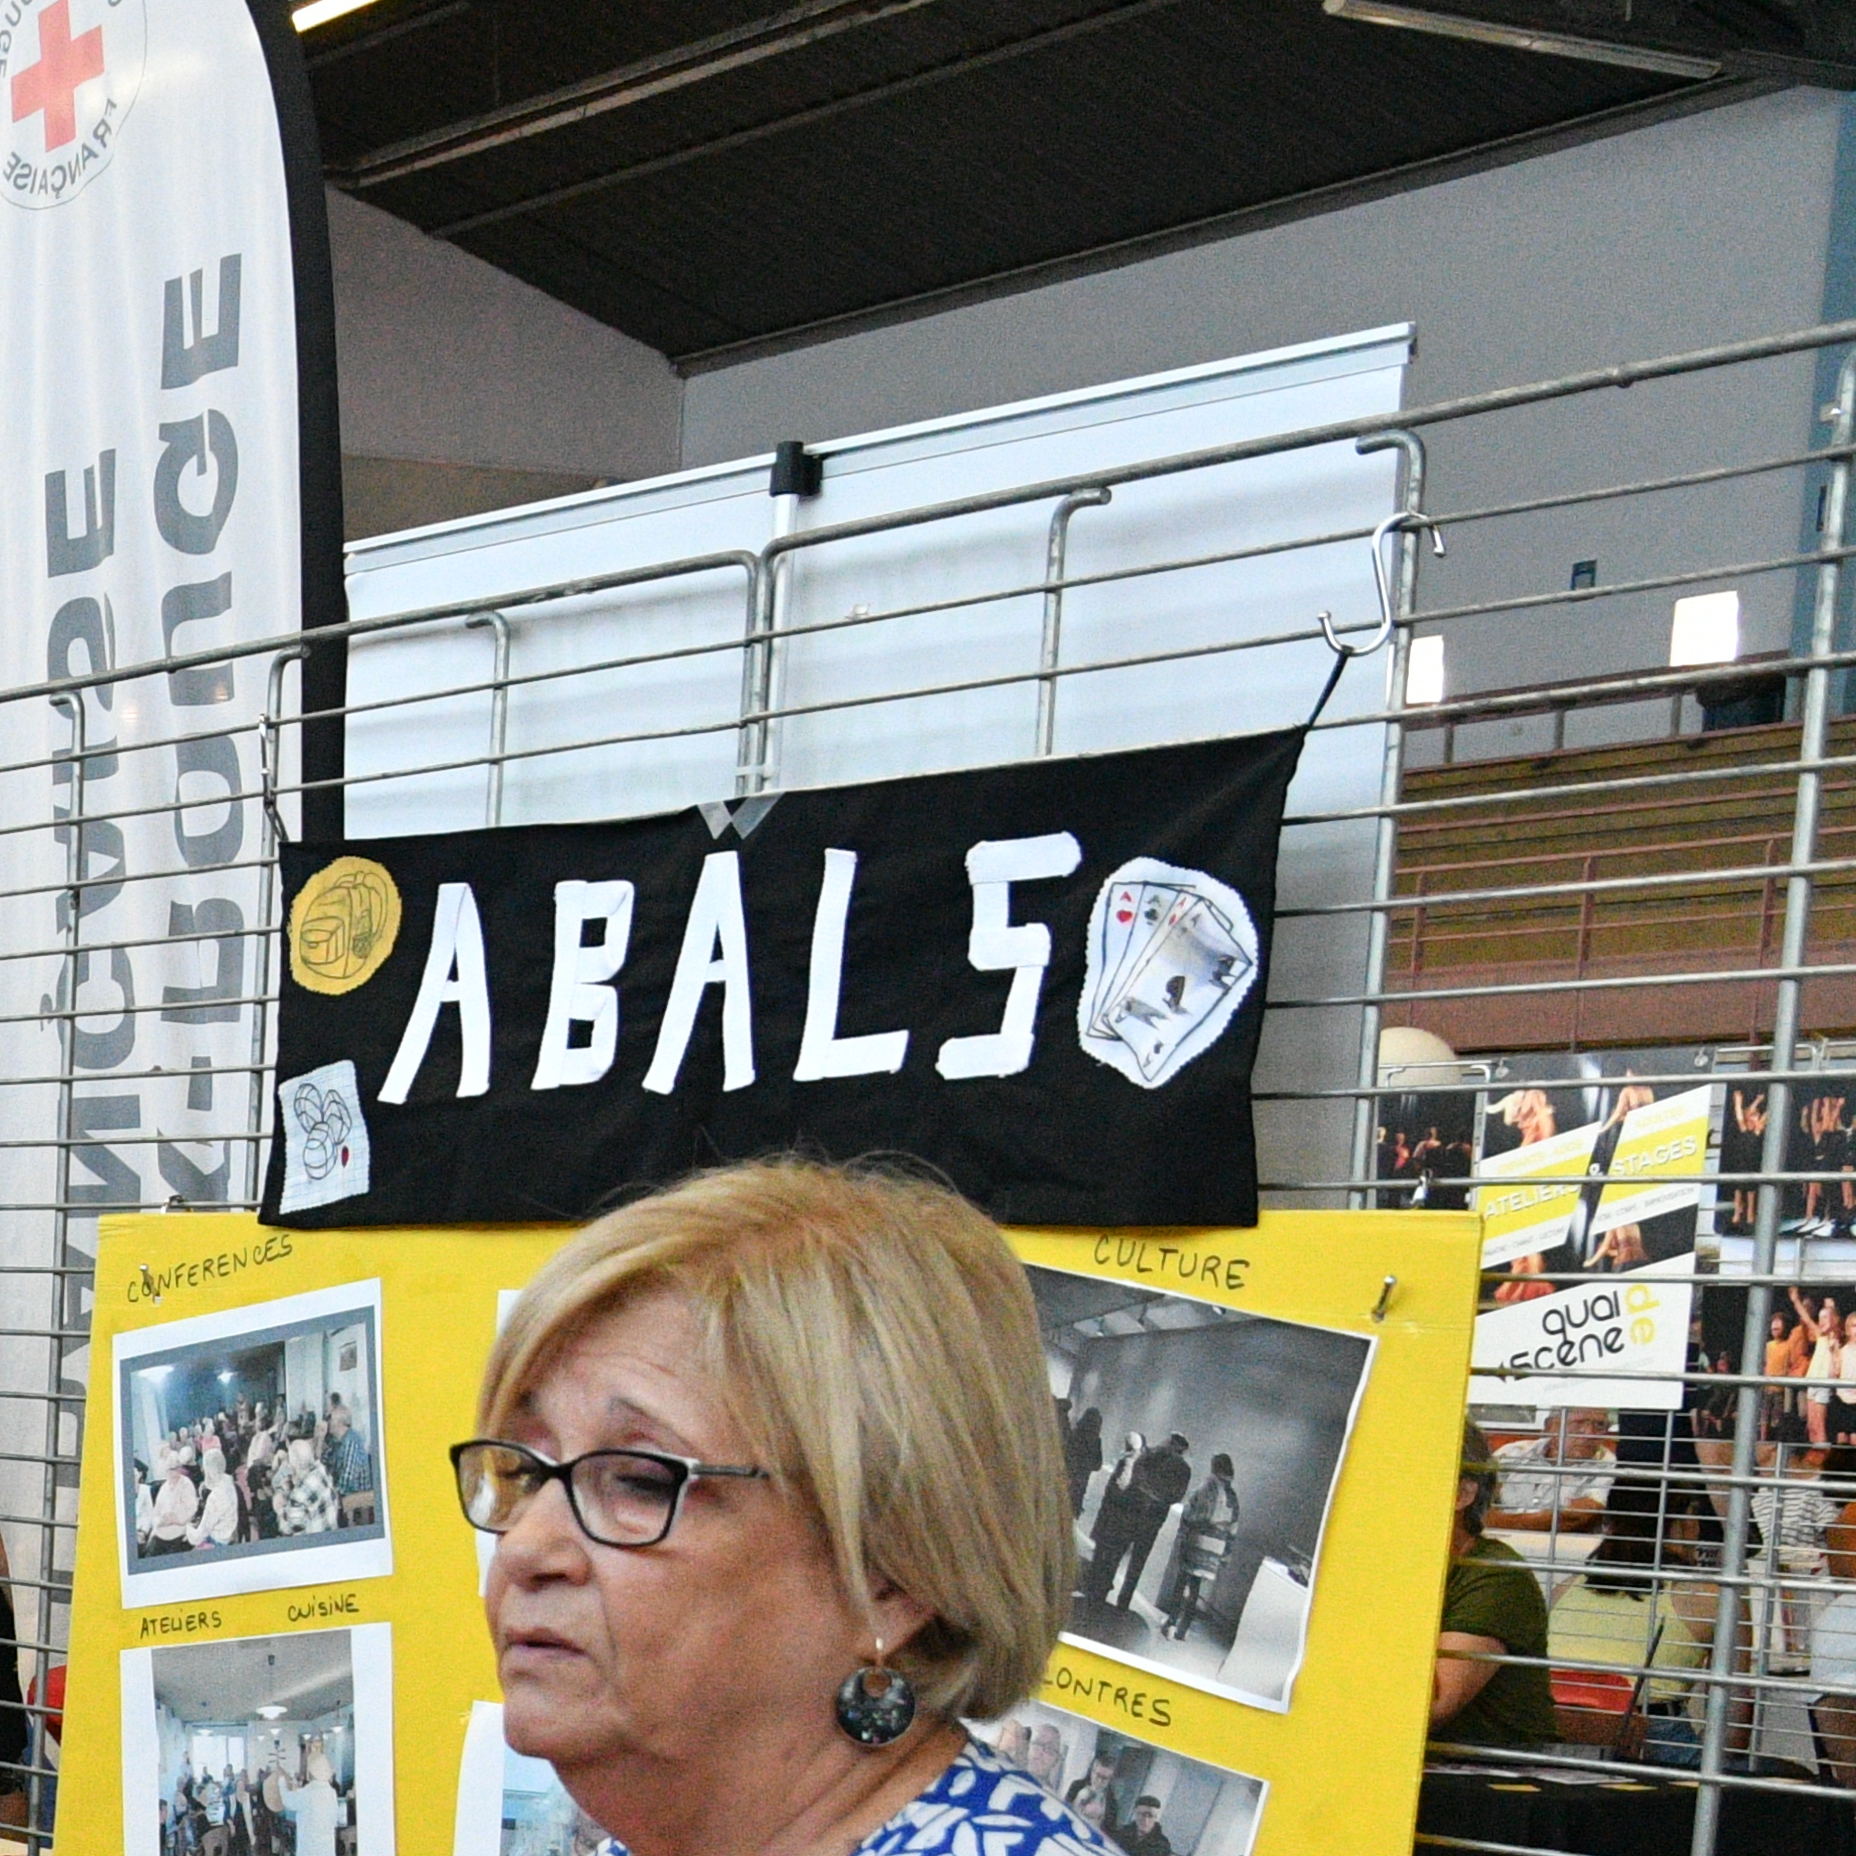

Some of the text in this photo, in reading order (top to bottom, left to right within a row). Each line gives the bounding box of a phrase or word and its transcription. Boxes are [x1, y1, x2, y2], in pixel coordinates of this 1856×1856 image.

[378, 831, 1083, 1104] ABALS
[1612, 1136, 1698, 1177] STAGES
[126, 1234, 293, 1303] CONFERENCES
[1094, 1233, 1251, 1292] CULTURE
[1542, 1290, 1621, 1341] quai
[1043, 1667, 1171, 1727] ONTRES
